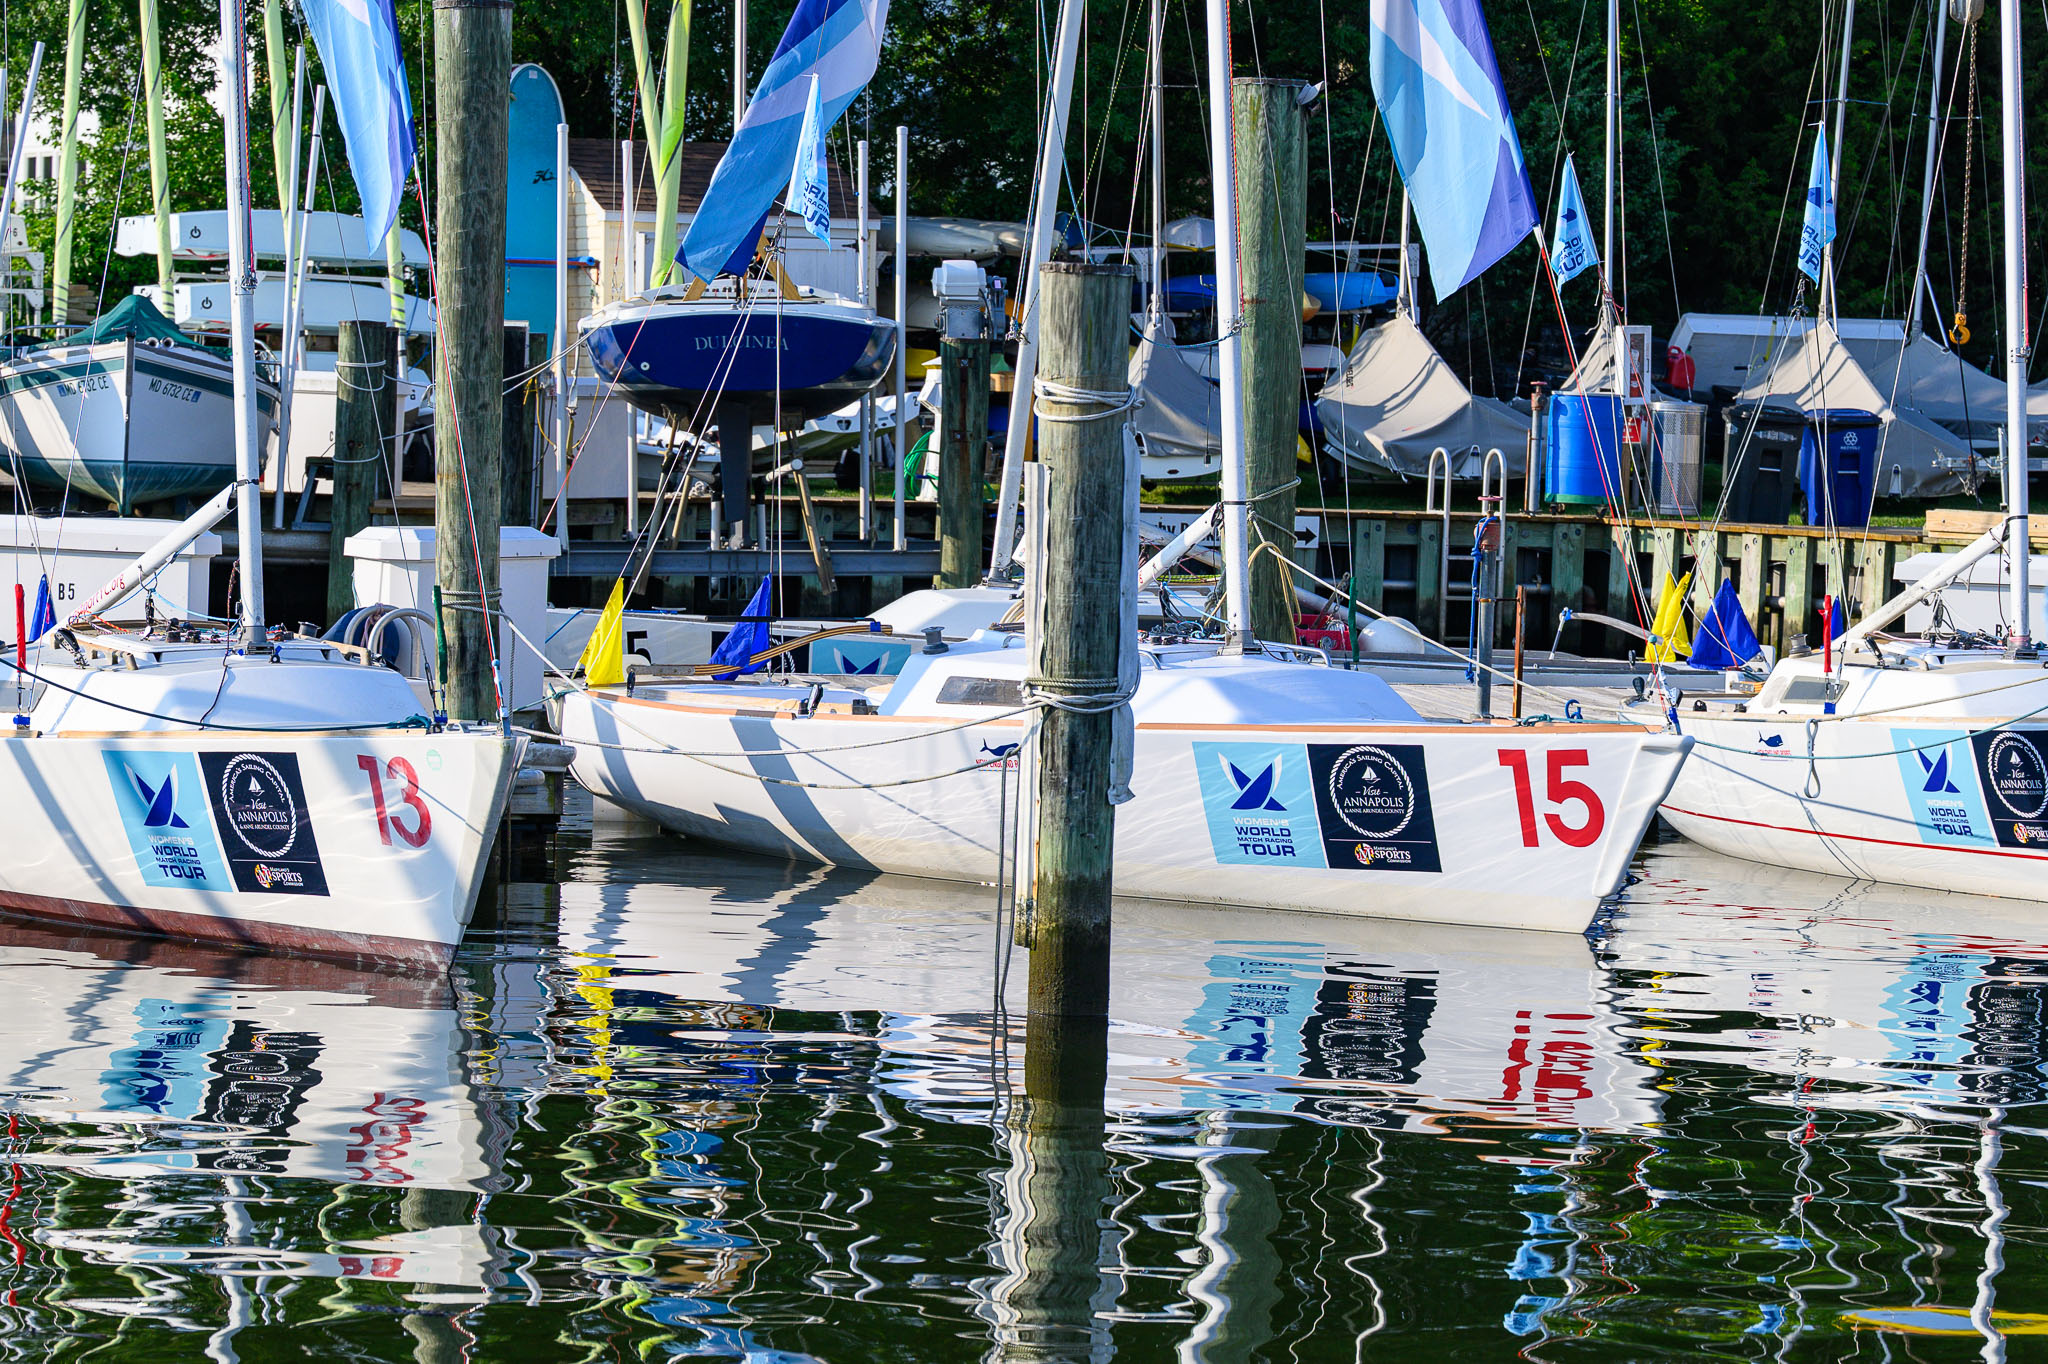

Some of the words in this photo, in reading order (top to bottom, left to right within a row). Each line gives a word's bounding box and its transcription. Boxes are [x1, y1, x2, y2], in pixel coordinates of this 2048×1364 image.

[694, 335, 789, 351] DULCINEA
[99, 375, 109, 389] CE
[149, 378, 161, 393] MD
[162, 382, 183, 398] 6732
[181, 387, 194, 401] CE
[58, 582, 75, 600] B5
[241, 763, 265, 774] SAILING
[1336, 758, 1356, 790] AMERICA'S
[1356, 754, 1383, 764] SAILING
[1383, 761, 1404, 790] CAPITAL
[1362, 785, 1381, 796] Visit
[2000, 779, 2043, 789] ANNAPOLIS
[356, 754, 432, 848] 13
[1343, 796, 1404, 808] ANNAPOLIS
[1497, 748, 1605, 848] 15
[237, 811, 288, 823] ANNAPOLIS
[1928, 807, 1967, 818] WORLD
[1233, 816, 1290, 827] WOMEN'S
[1235, 826, 1292, 837] WORLD
[1933, 823, 1974, 837] TOUR
[147, 834, 195, 846] WOMEN'S
[151, 844, 199, 858] WORLD
[1239, 843, 1297, 857] TOUR
[1374, 850, 1411, 860] SPORTS
[158, 864, 207, 880] TOUR
[271, 871, 303, 882] SPORTS
